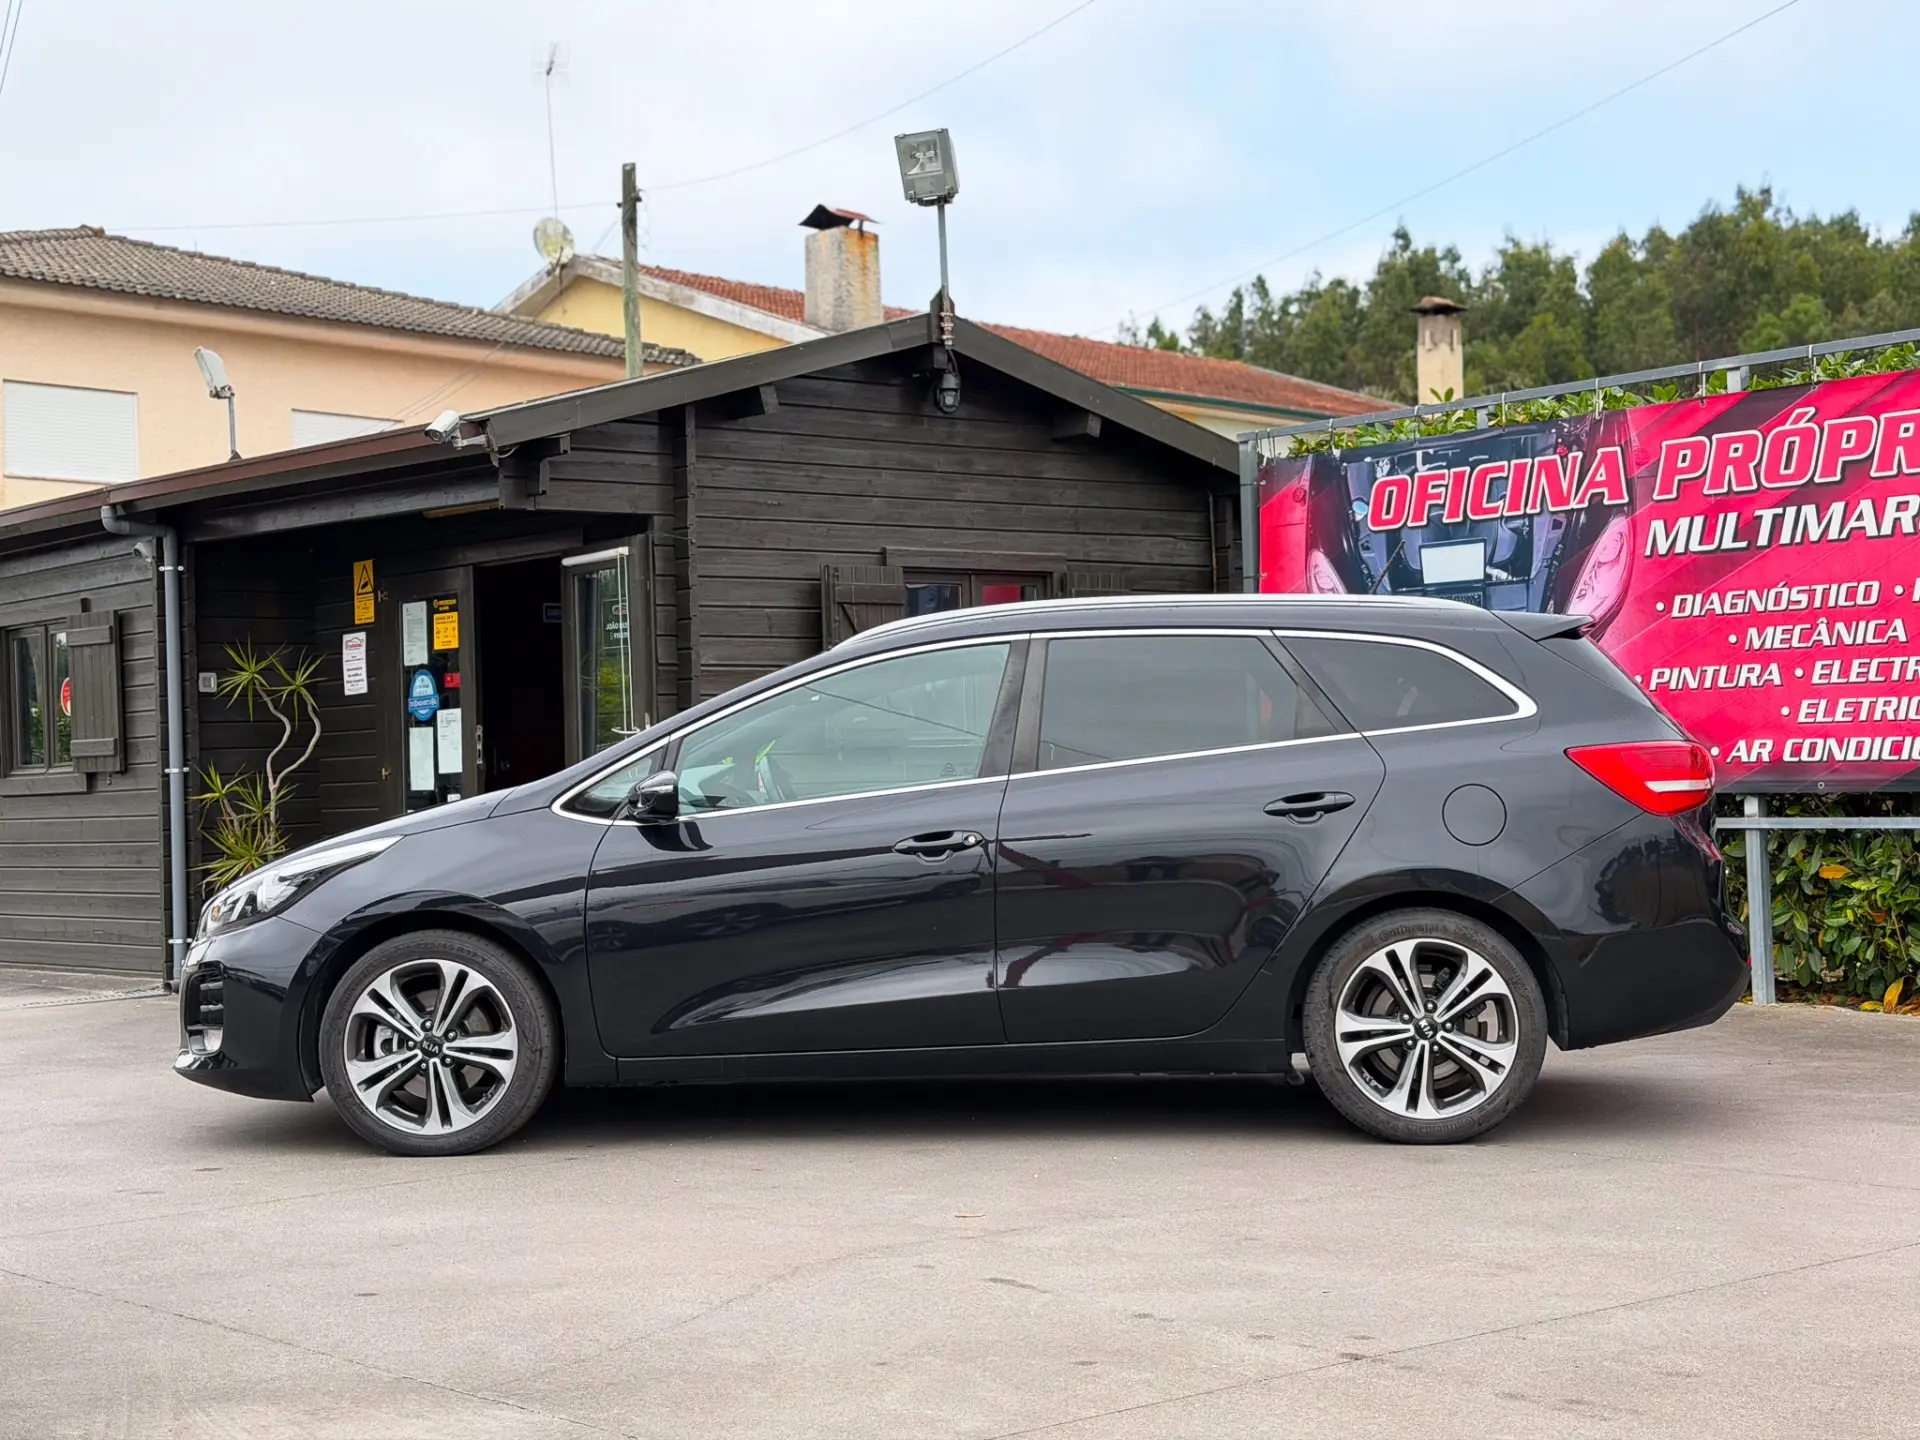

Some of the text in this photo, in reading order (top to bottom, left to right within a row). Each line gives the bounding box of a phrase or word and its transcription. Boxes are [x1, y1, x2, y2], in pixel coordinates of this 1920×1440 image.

[1367, 406, 1920, 531] OFICINA PRÓPR
[1644, 494, 1920, 556] MULTIMAR
[1671, 580, 1880, 618] DIAGNÓSTICO
[1745, 617, 1907, 650] MECÂNICA
[1649, 656, 1920, 691] PINTURA ELECTR
[1726, 739, 1774, 763] AR
[1419, 1019, 1434, 1039] KIA
[422, 1040, 440, 1054] KIA
